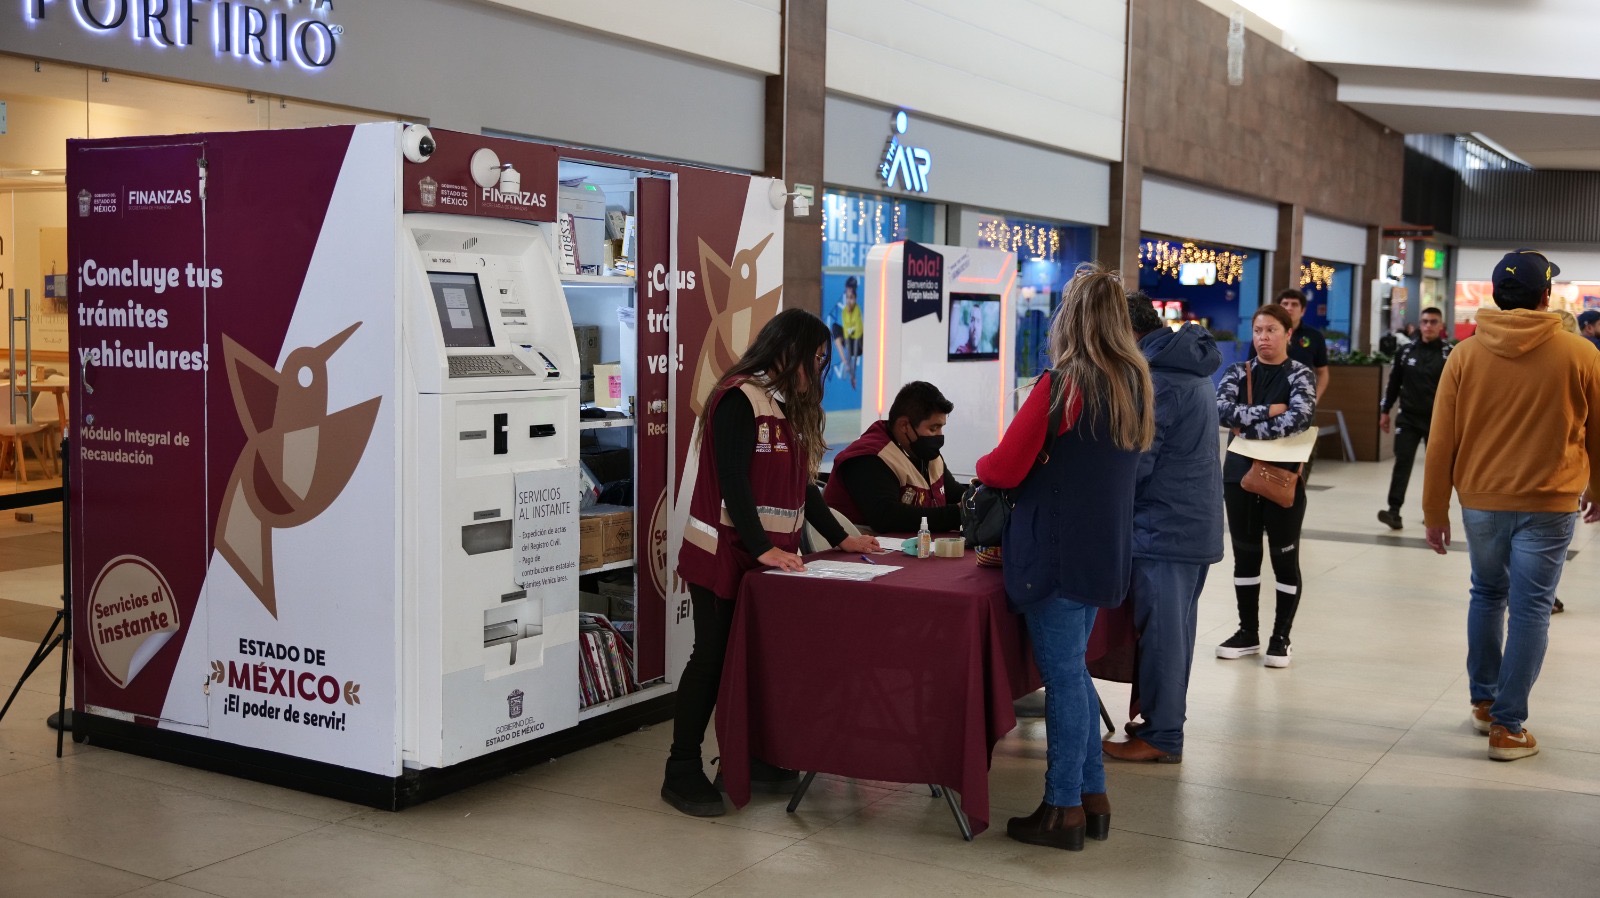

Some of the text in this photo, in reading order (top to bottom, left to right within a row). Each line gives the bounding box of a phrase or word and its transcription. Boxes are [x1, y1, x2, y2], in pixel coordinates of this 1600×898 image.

[129, 189, 192, 204] FINANZAS
[441, 190, 460, 198] ESTADO
[441, 196, 468, 207] MÉXICO
[482, 187, 547, 208] FINANZAS
[94, 205, 117, 213] MÉXICO
[908, 253, 940, 277] hola!
[78, 259, 223, 294] ¡Concluye tus
[907, 279, 934, 290] Bienvenido
[907, 289, 940, 302] Virgin Mobile
[78, 300, 169, 328] trámites
[78, 340, 209, 372] vehiculares!
[80, 426, 190, 447] Módulo Integral de
[80, 447, 154, 465] Recaudación
[519, 487, 560, 504] SERVICIOS
[519, 501, 570, 520] AL INSTANTE
[522, 528, 547, 539] Expedición
[554, 526, 567, 534] actas
[530, 540, 550, 552] Registro
[522, 554, 541, 566] Pago de
[522, 565, 554, 577] contribuciones
[95, 585, 164, 620] Servicios al
[98, 610, 170, 645] instante
[239, 637, 326, 667] ESTADO DE
[228, 660, 341, 705] MÉXICO
[223, 694, 346, 731] ¡El poder de servir!
[495, 716, 536, 734] GOBIERNO DEL
[486, 722, 545, 747] ESTADO DE MÉXICO
